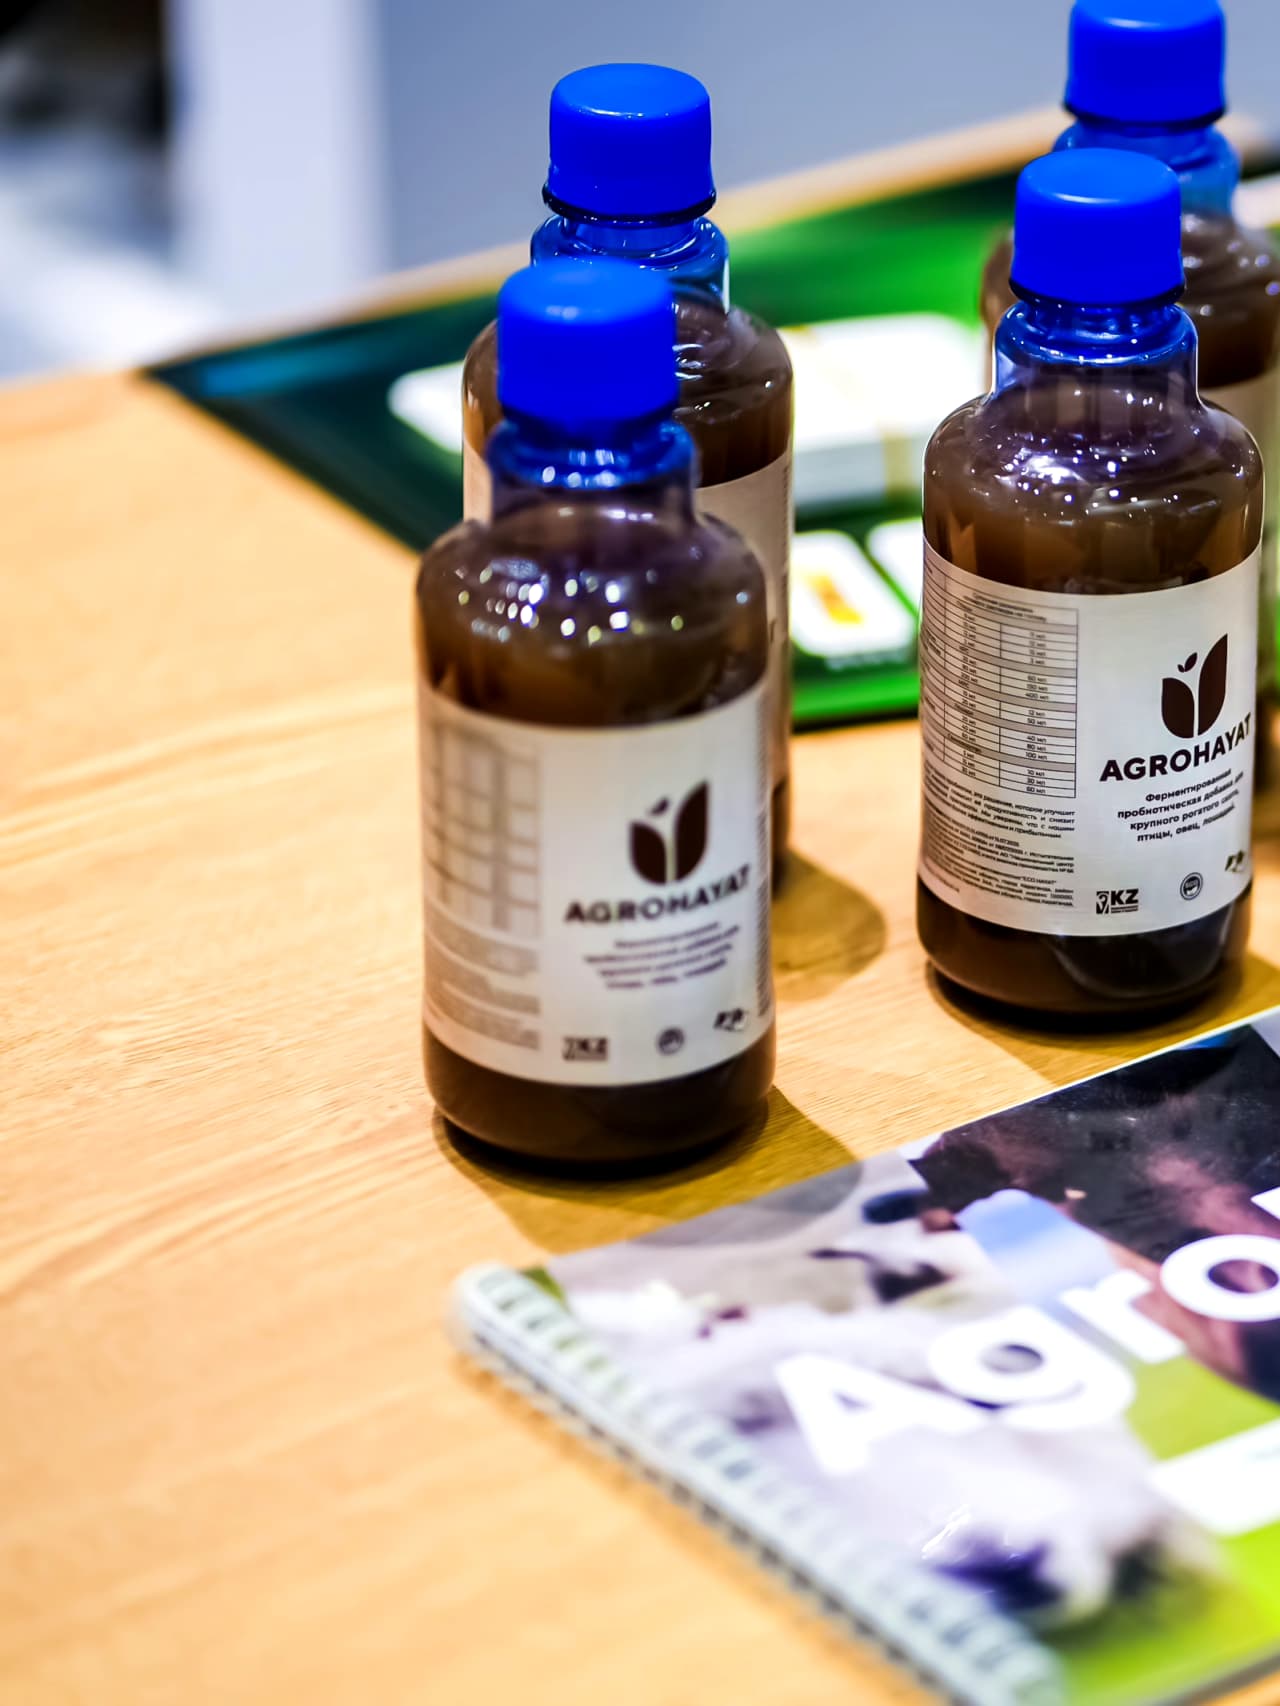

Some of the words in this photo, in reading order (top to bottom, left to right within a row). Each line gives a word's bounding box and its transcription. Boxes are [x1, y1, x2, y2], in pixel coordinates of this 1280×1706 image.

[1099, 711, 1251, 782] AGROHAYAT
[1117, 796, 1202, 820] пробиотическая
[1130, 815, 1180, 831] крупного
[1182, 800, 1219, 822] рогатого
[1137, 830, 1173, 843] птицы,
[1111, 888, 1139, 906] KZ
